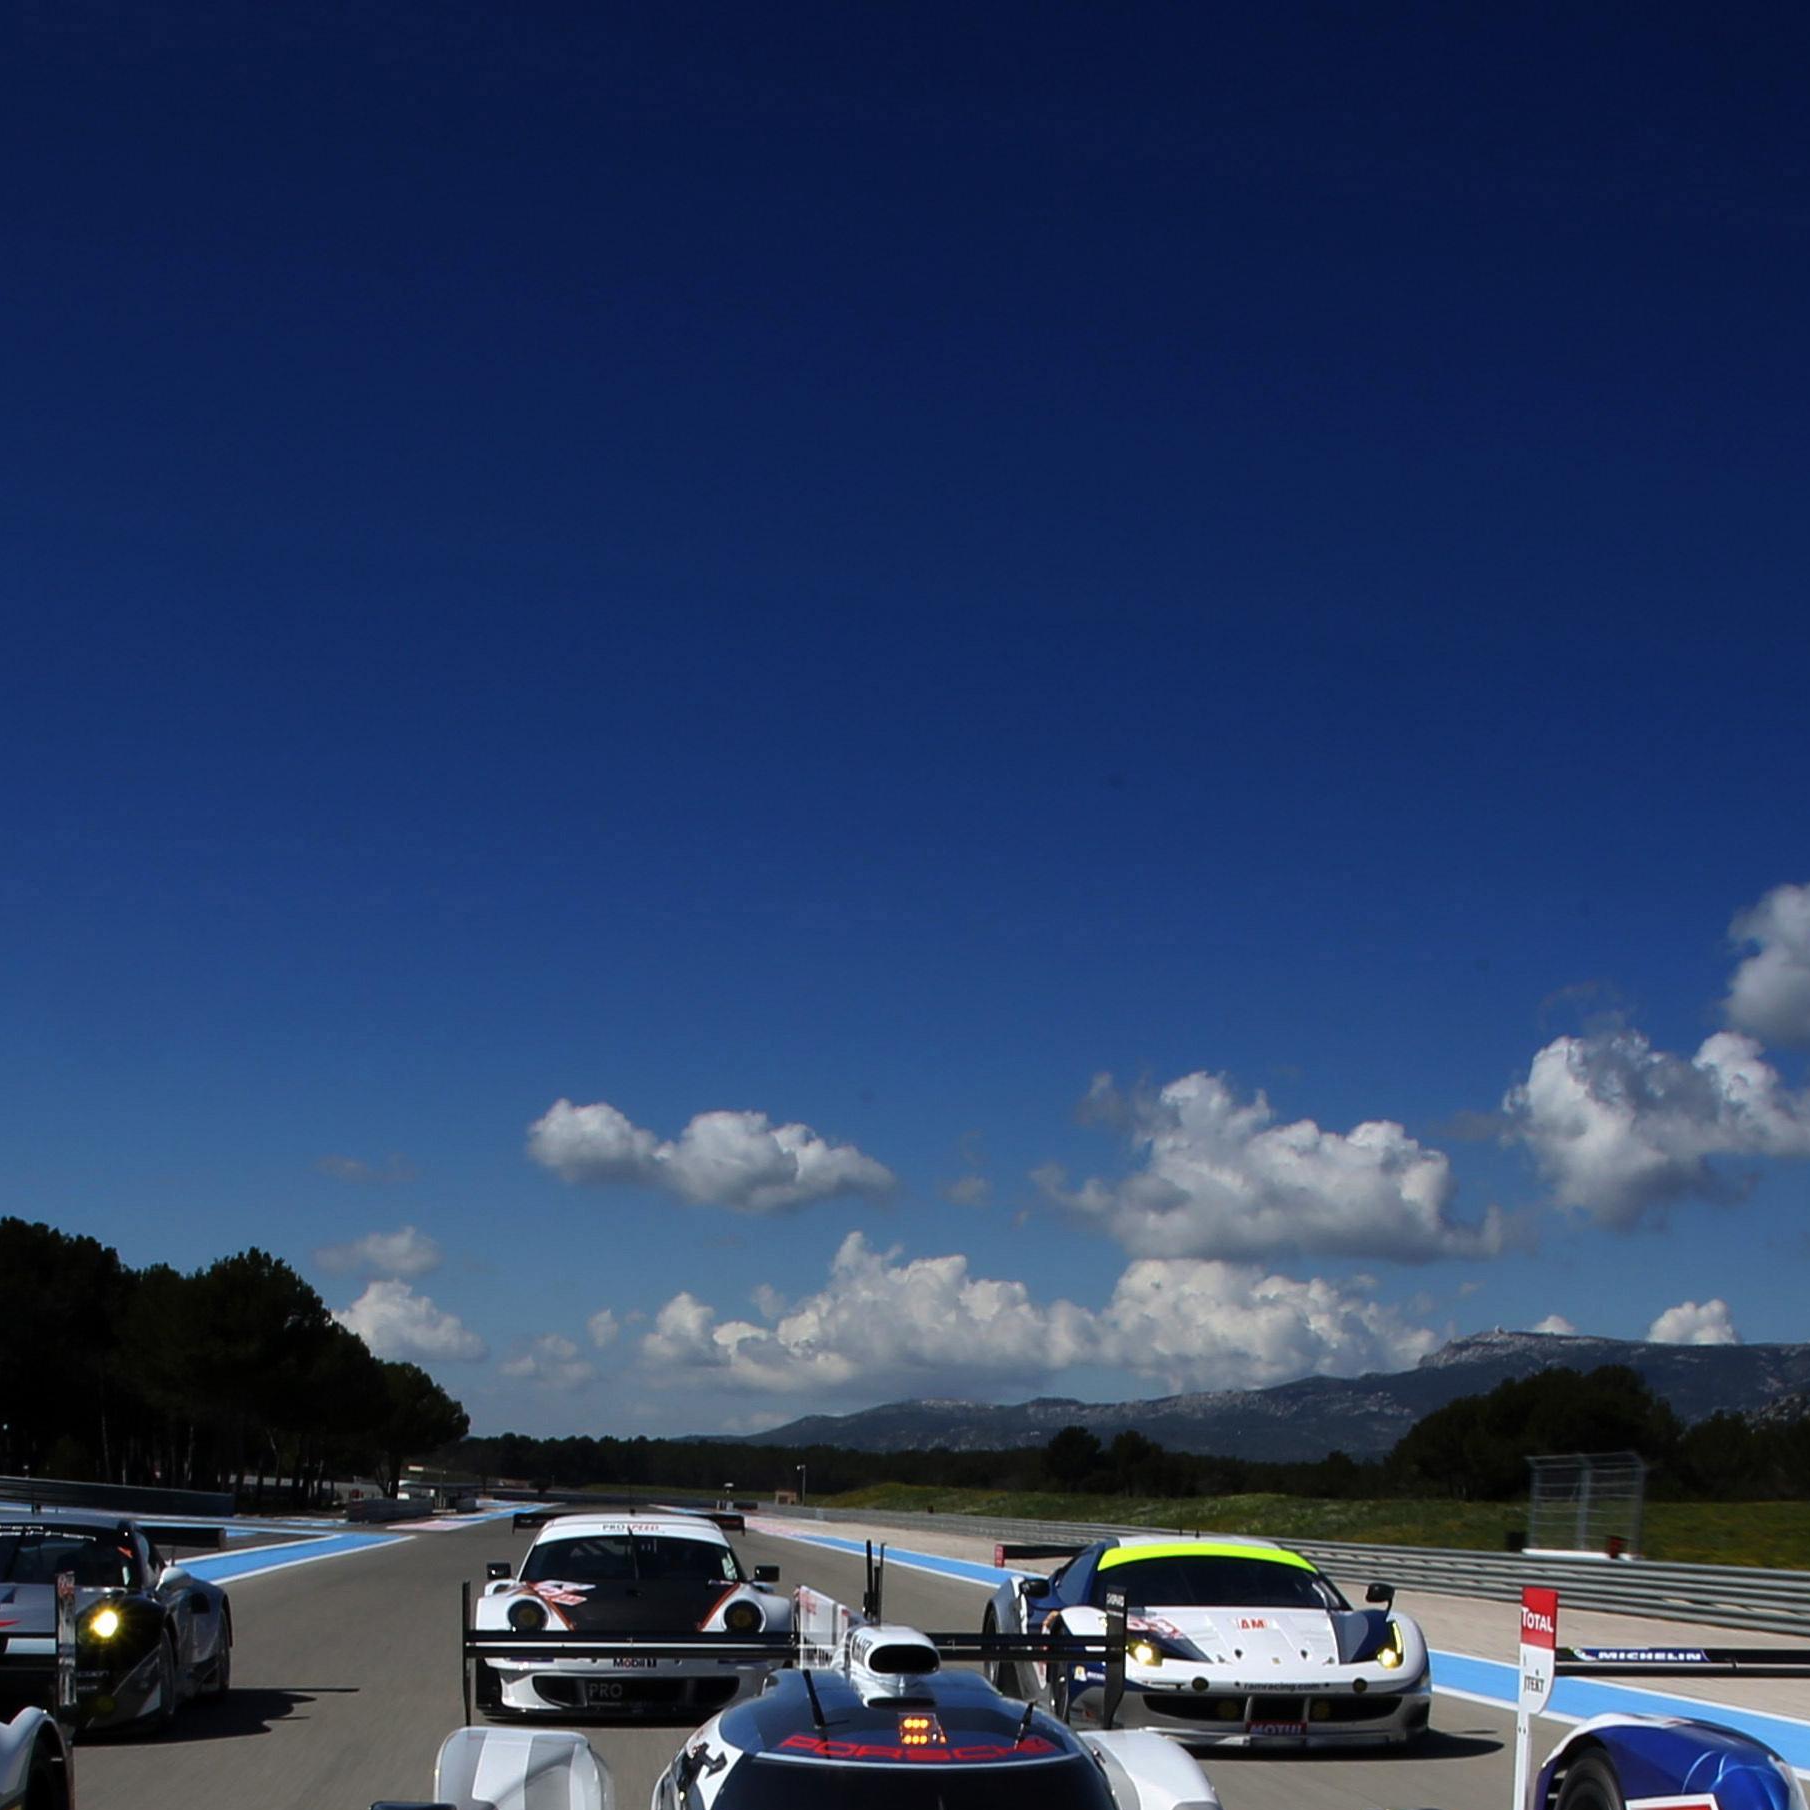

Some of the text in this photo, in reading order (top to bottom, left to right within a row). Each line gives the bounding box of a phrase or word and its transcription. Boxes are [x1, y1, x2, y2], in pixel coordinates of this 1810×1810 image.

[1241, 1618, 1264, 1629] AM
[1522, 1607, 1553, 1633] TOTAL
[1598, 1651, 1701, 1661] MICHELIN
[613, 1658, 645, 1667] Mobil
[589, 1683, 622, 1698] PRO
